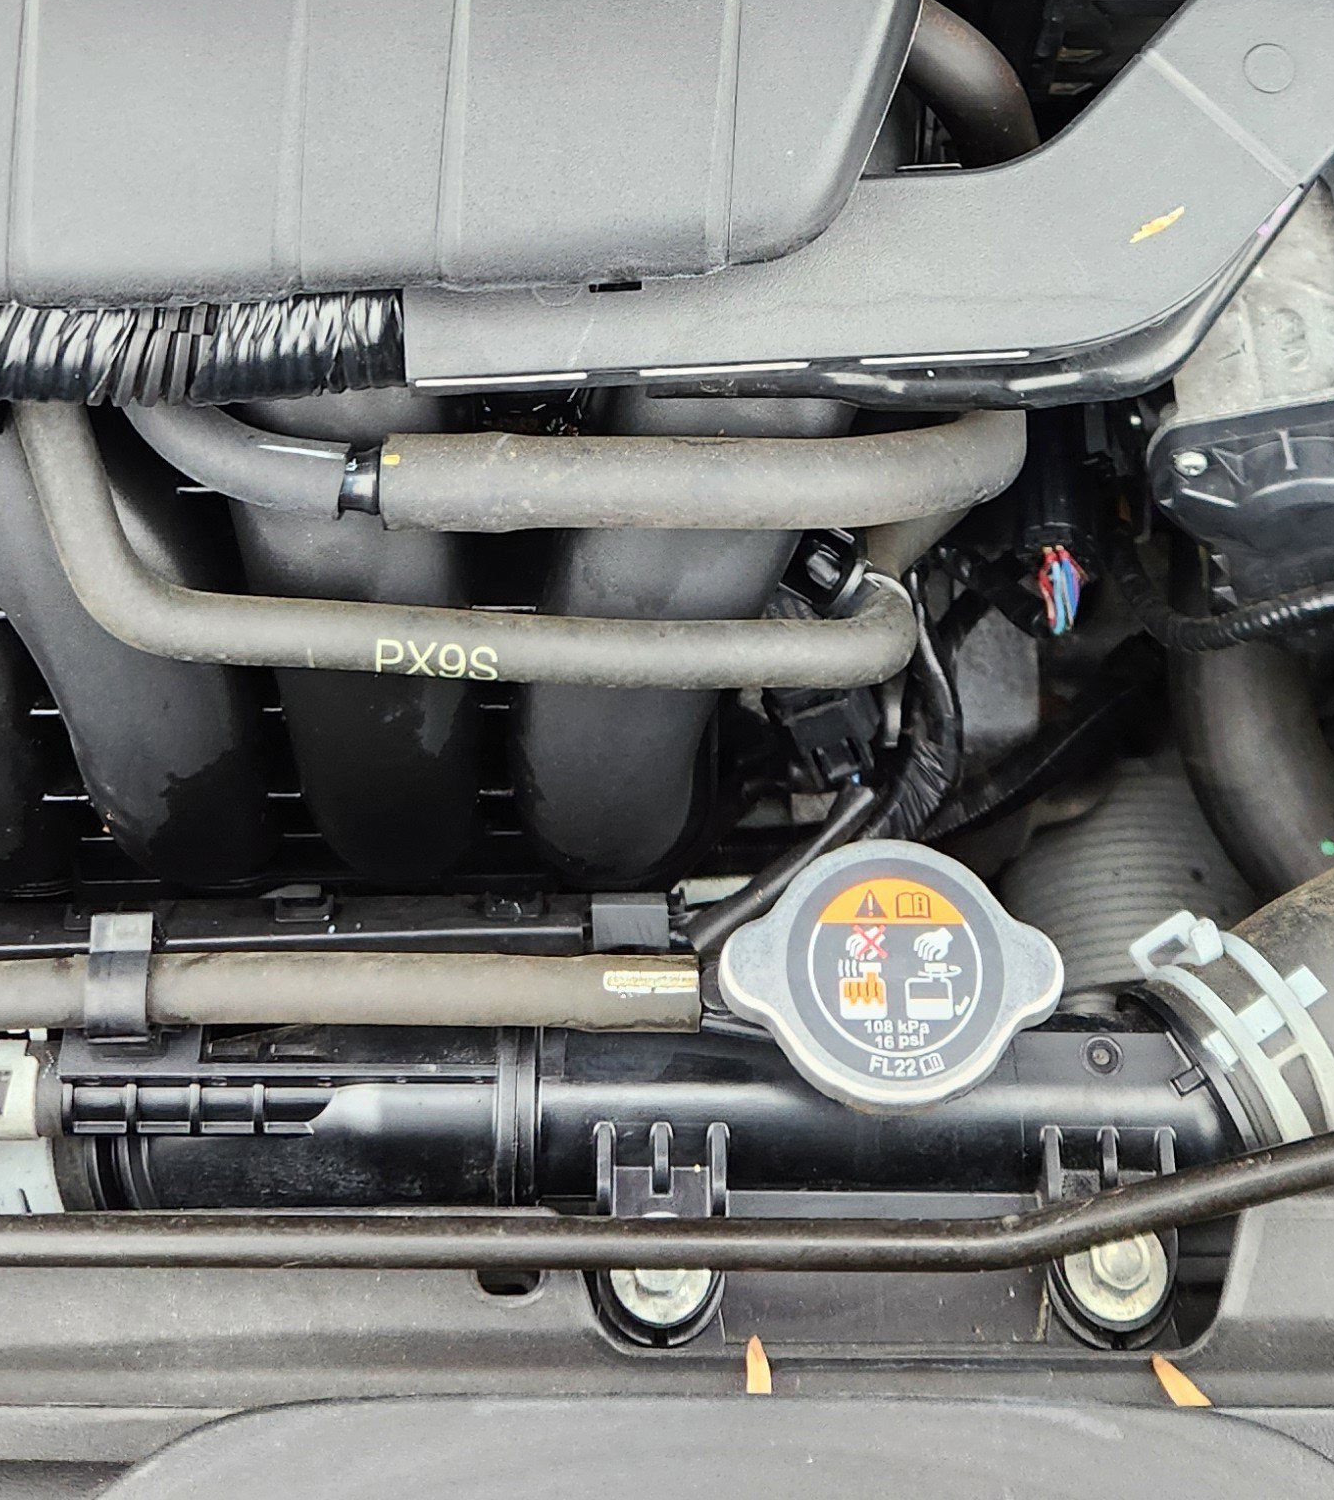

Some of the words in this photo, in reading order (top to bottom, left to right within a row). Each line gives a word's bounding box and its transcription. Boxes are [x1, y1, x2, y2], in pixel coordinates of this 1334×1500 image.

[375, 638, 499, 681] PX9S
[863, 1020, 894, 1034] 108
[897, 1019, 930, 1035] kPa
[874, 1035, 895, 1049] 16
[898, 1033, 926, 1049] psi
[868, 1054, 919, 1078] FL22
